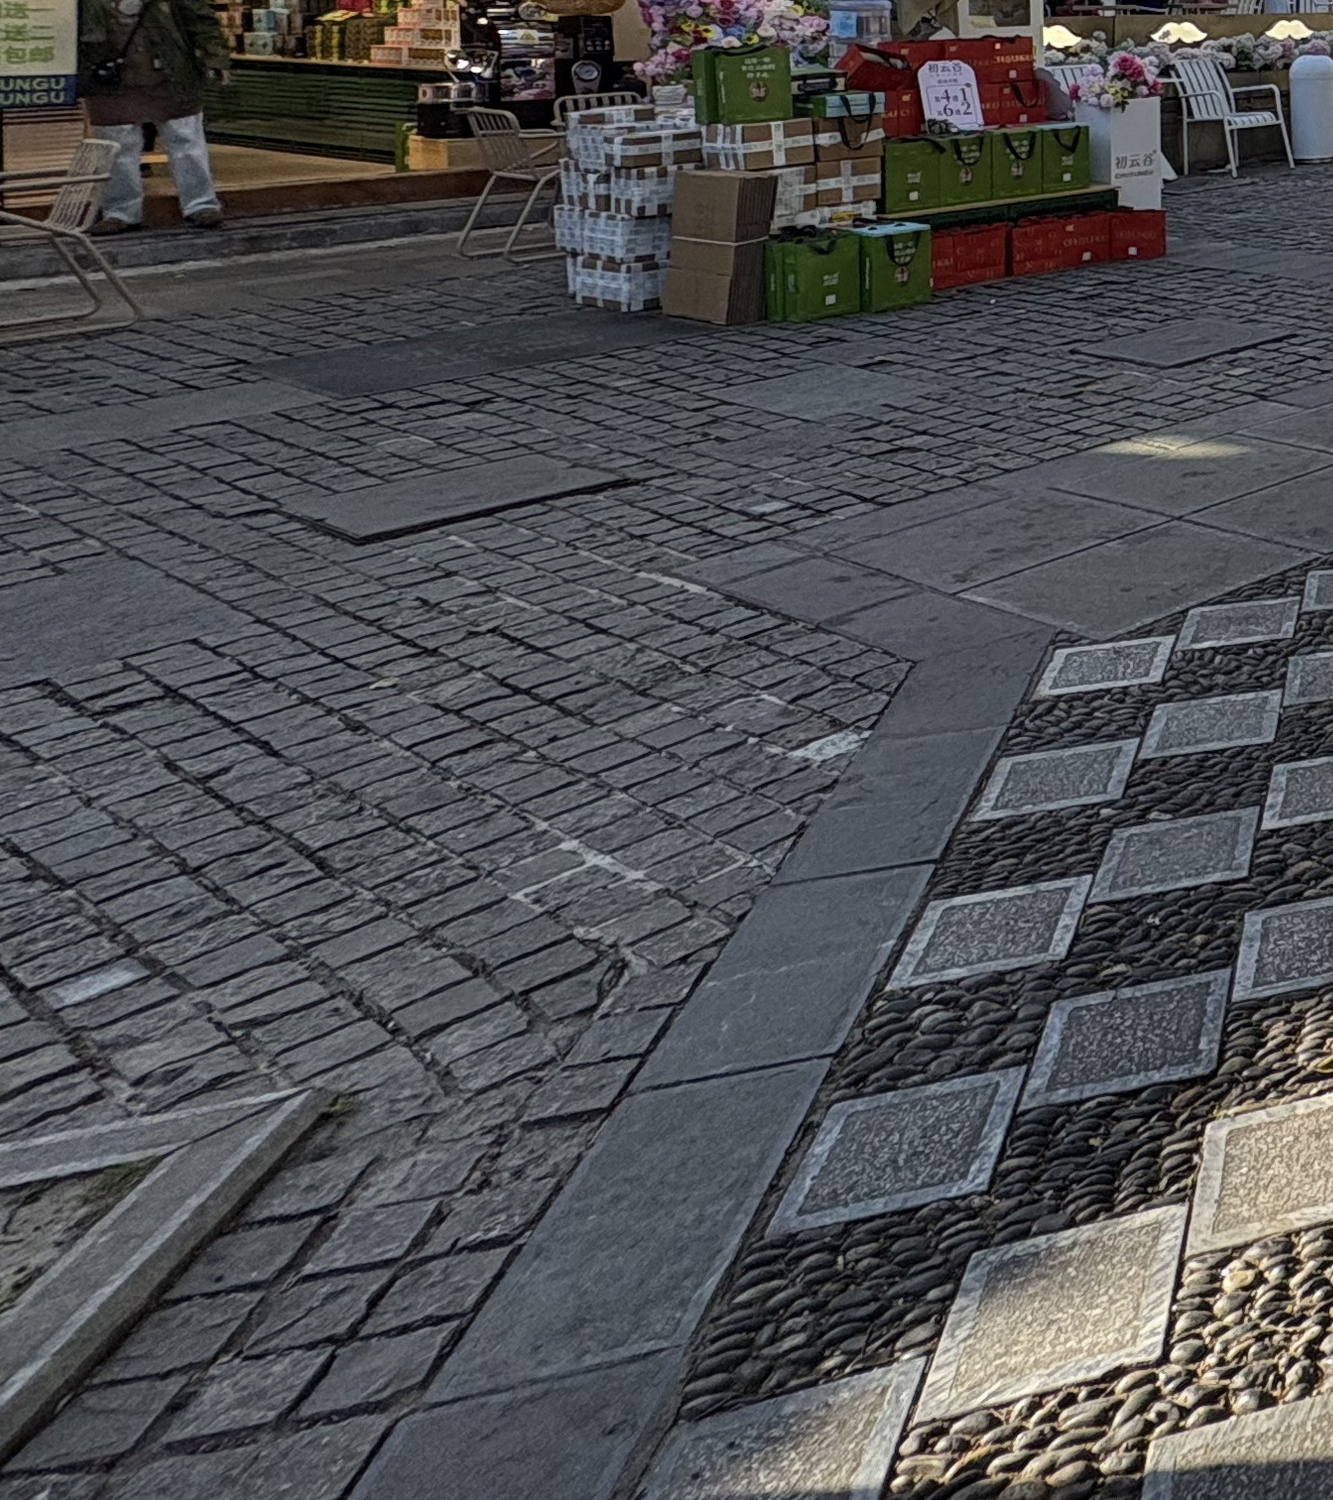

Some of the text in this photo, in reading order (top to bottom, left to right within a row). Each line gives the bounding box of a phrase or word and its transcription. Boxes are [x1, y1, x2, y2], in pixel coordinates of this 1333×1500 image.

[0, 1, 56, 19] 送一
[0, 23, 55, 42] 送二
[1115, 153, 1153, 169] 初云谷
